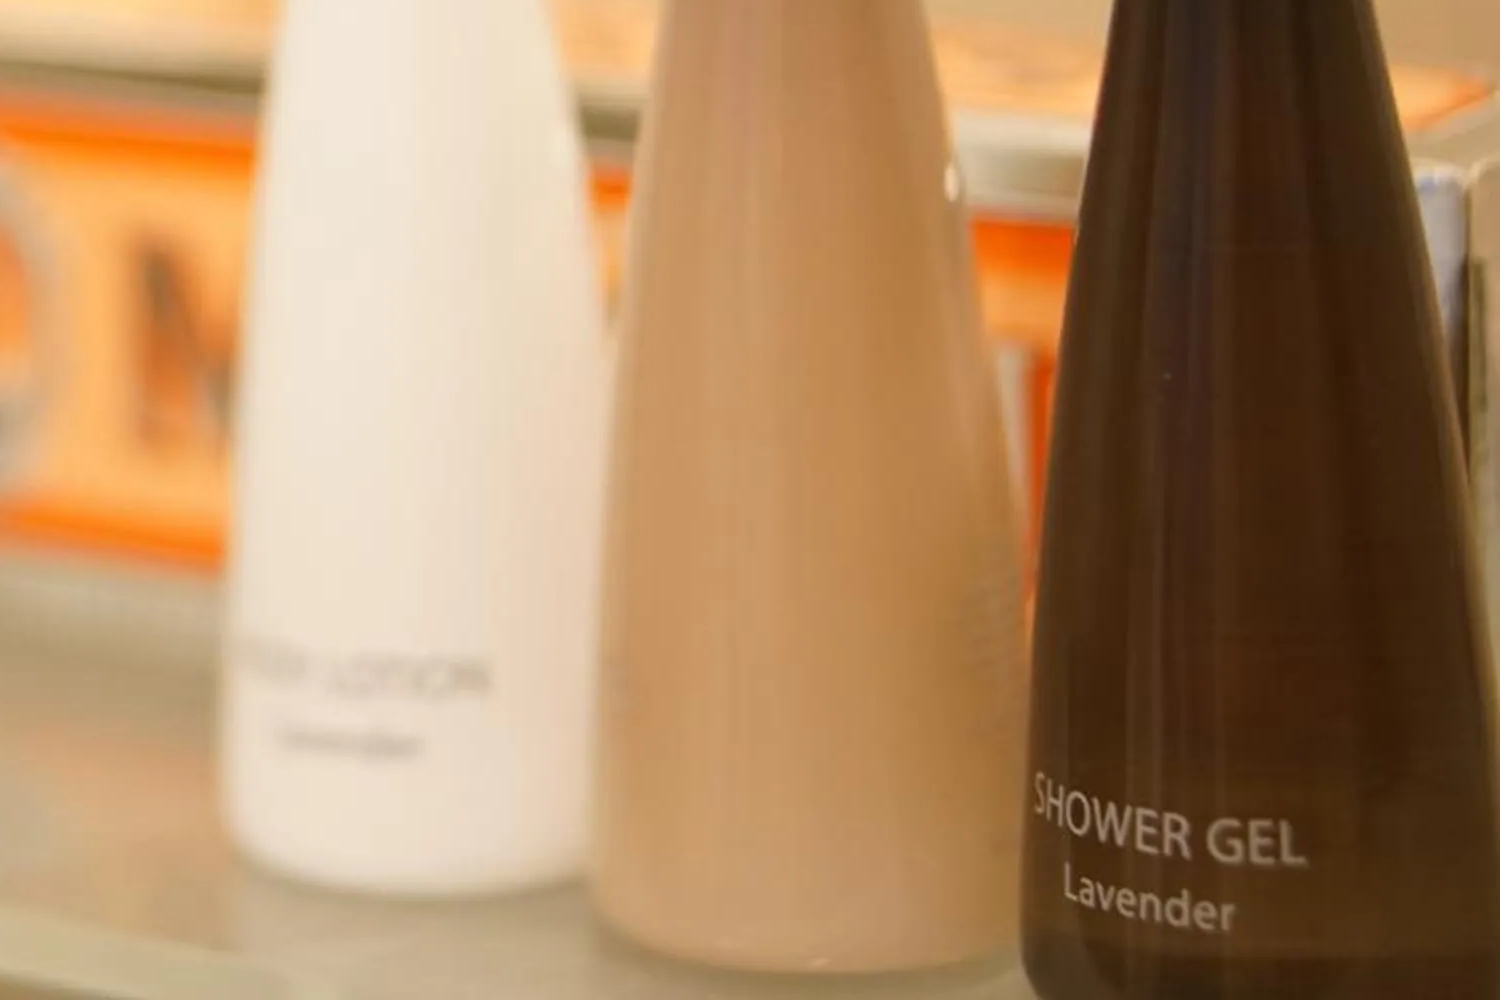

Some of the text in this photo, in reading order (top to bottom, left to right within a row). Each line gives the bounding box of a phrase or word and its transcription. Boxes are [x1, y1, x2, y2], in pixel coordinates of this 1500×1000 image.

[1033, 771, 1307, 865] SHOWER GEL
[1063, 861, 1235, 931] Lavender
